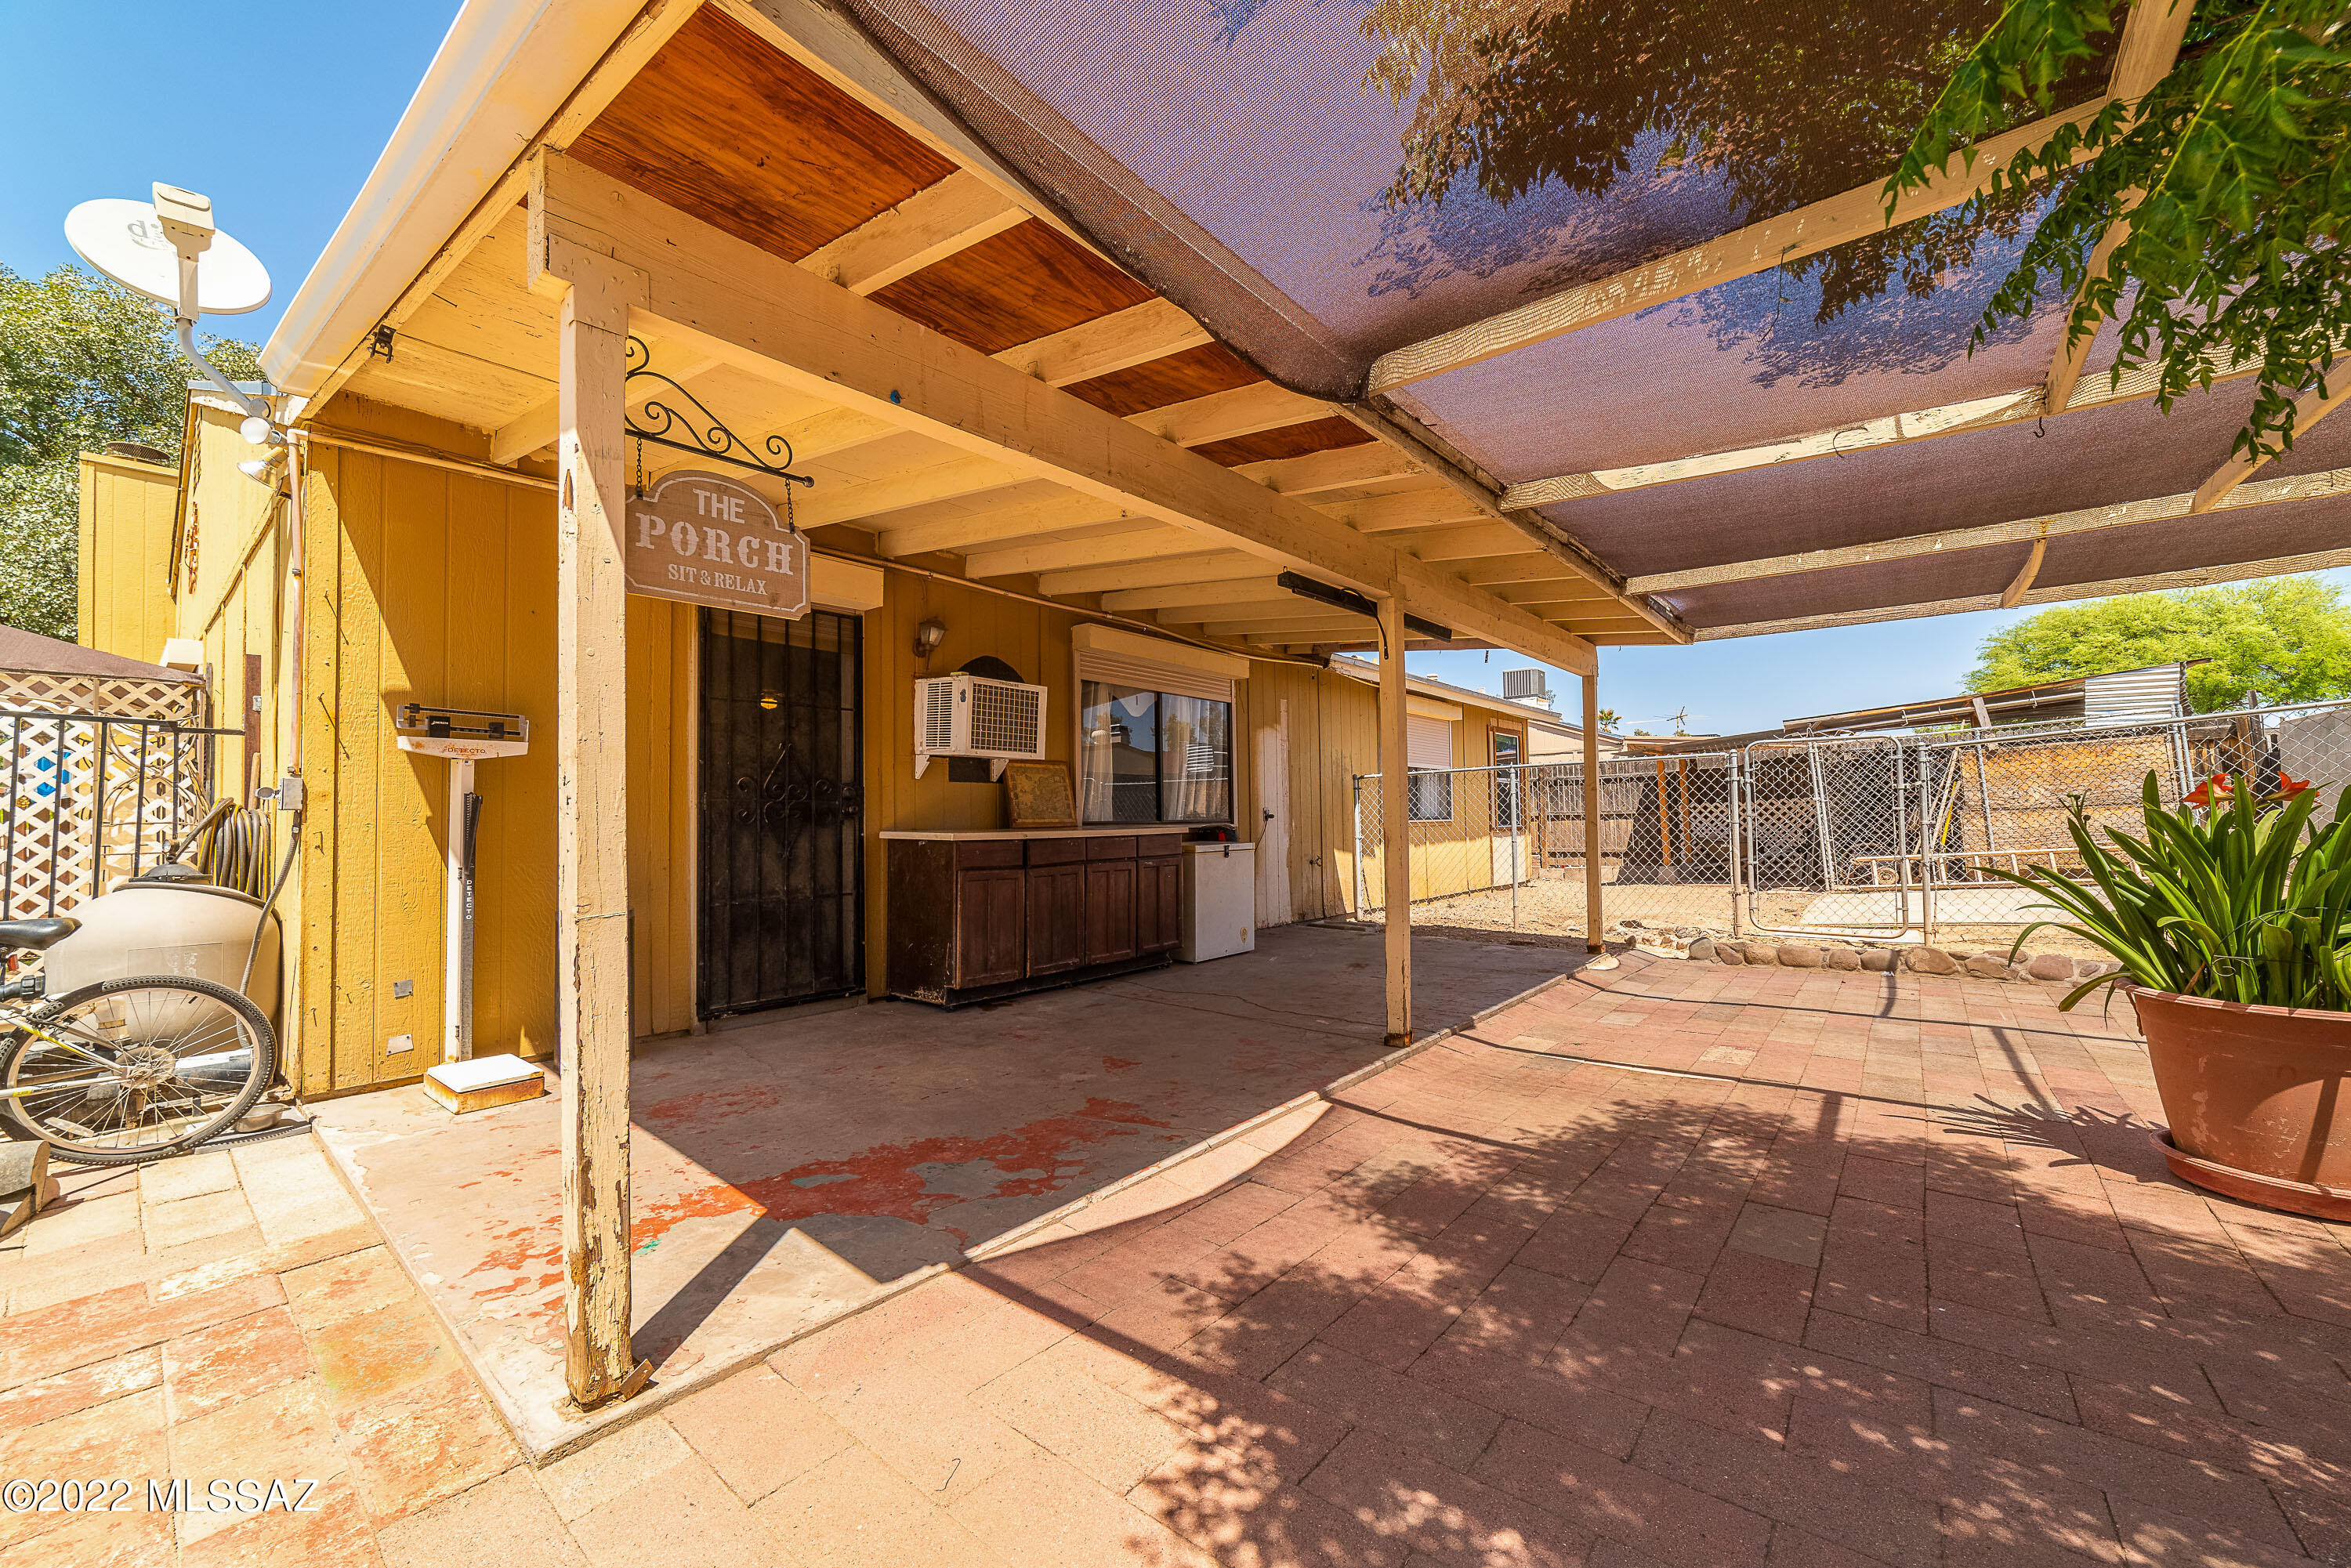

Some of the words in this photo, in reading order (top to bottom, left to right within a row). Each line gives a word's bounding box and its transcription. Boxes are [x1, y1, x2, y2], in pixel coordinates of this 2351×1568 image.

[693, 487, 745, 524] THE
[635, 512, 794, 576] PORCH
[668, 563, 697, 583] SIT
[700, 569, 712, 586] &
[713, 570, 769, 596] RELAX
